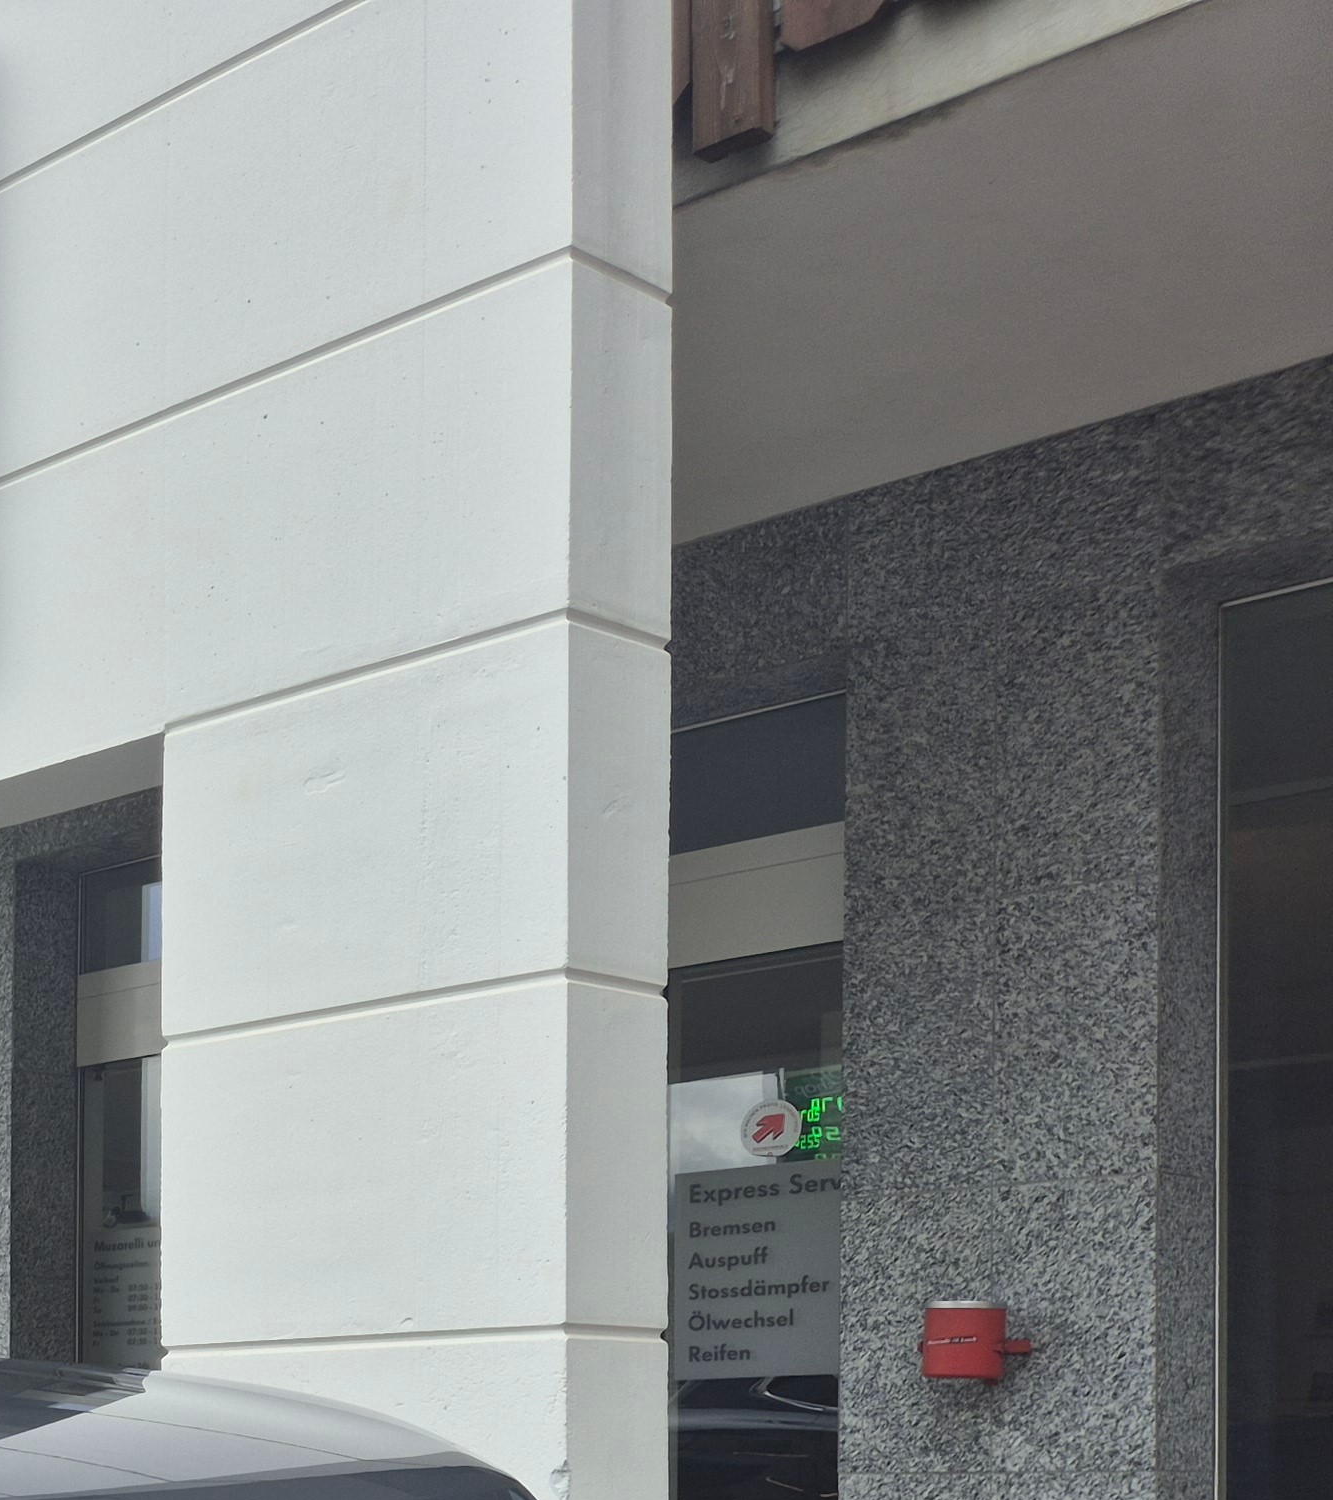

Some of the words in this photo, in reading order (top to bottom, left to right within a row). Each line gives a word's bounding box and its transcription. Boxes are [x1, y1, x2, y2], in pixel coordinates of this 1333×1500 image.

[688, 1183, 780, 1206] Express
[688, 1220, 777, 1238] Bremsen
[688, 1246, 769, 1271] Auspuff
[688, 1274, 830, 1301] Stossdämpfer
[688, 1308, 794, 1331] Ölwechsel
[688, 1343, 751, 1362] Reifen
